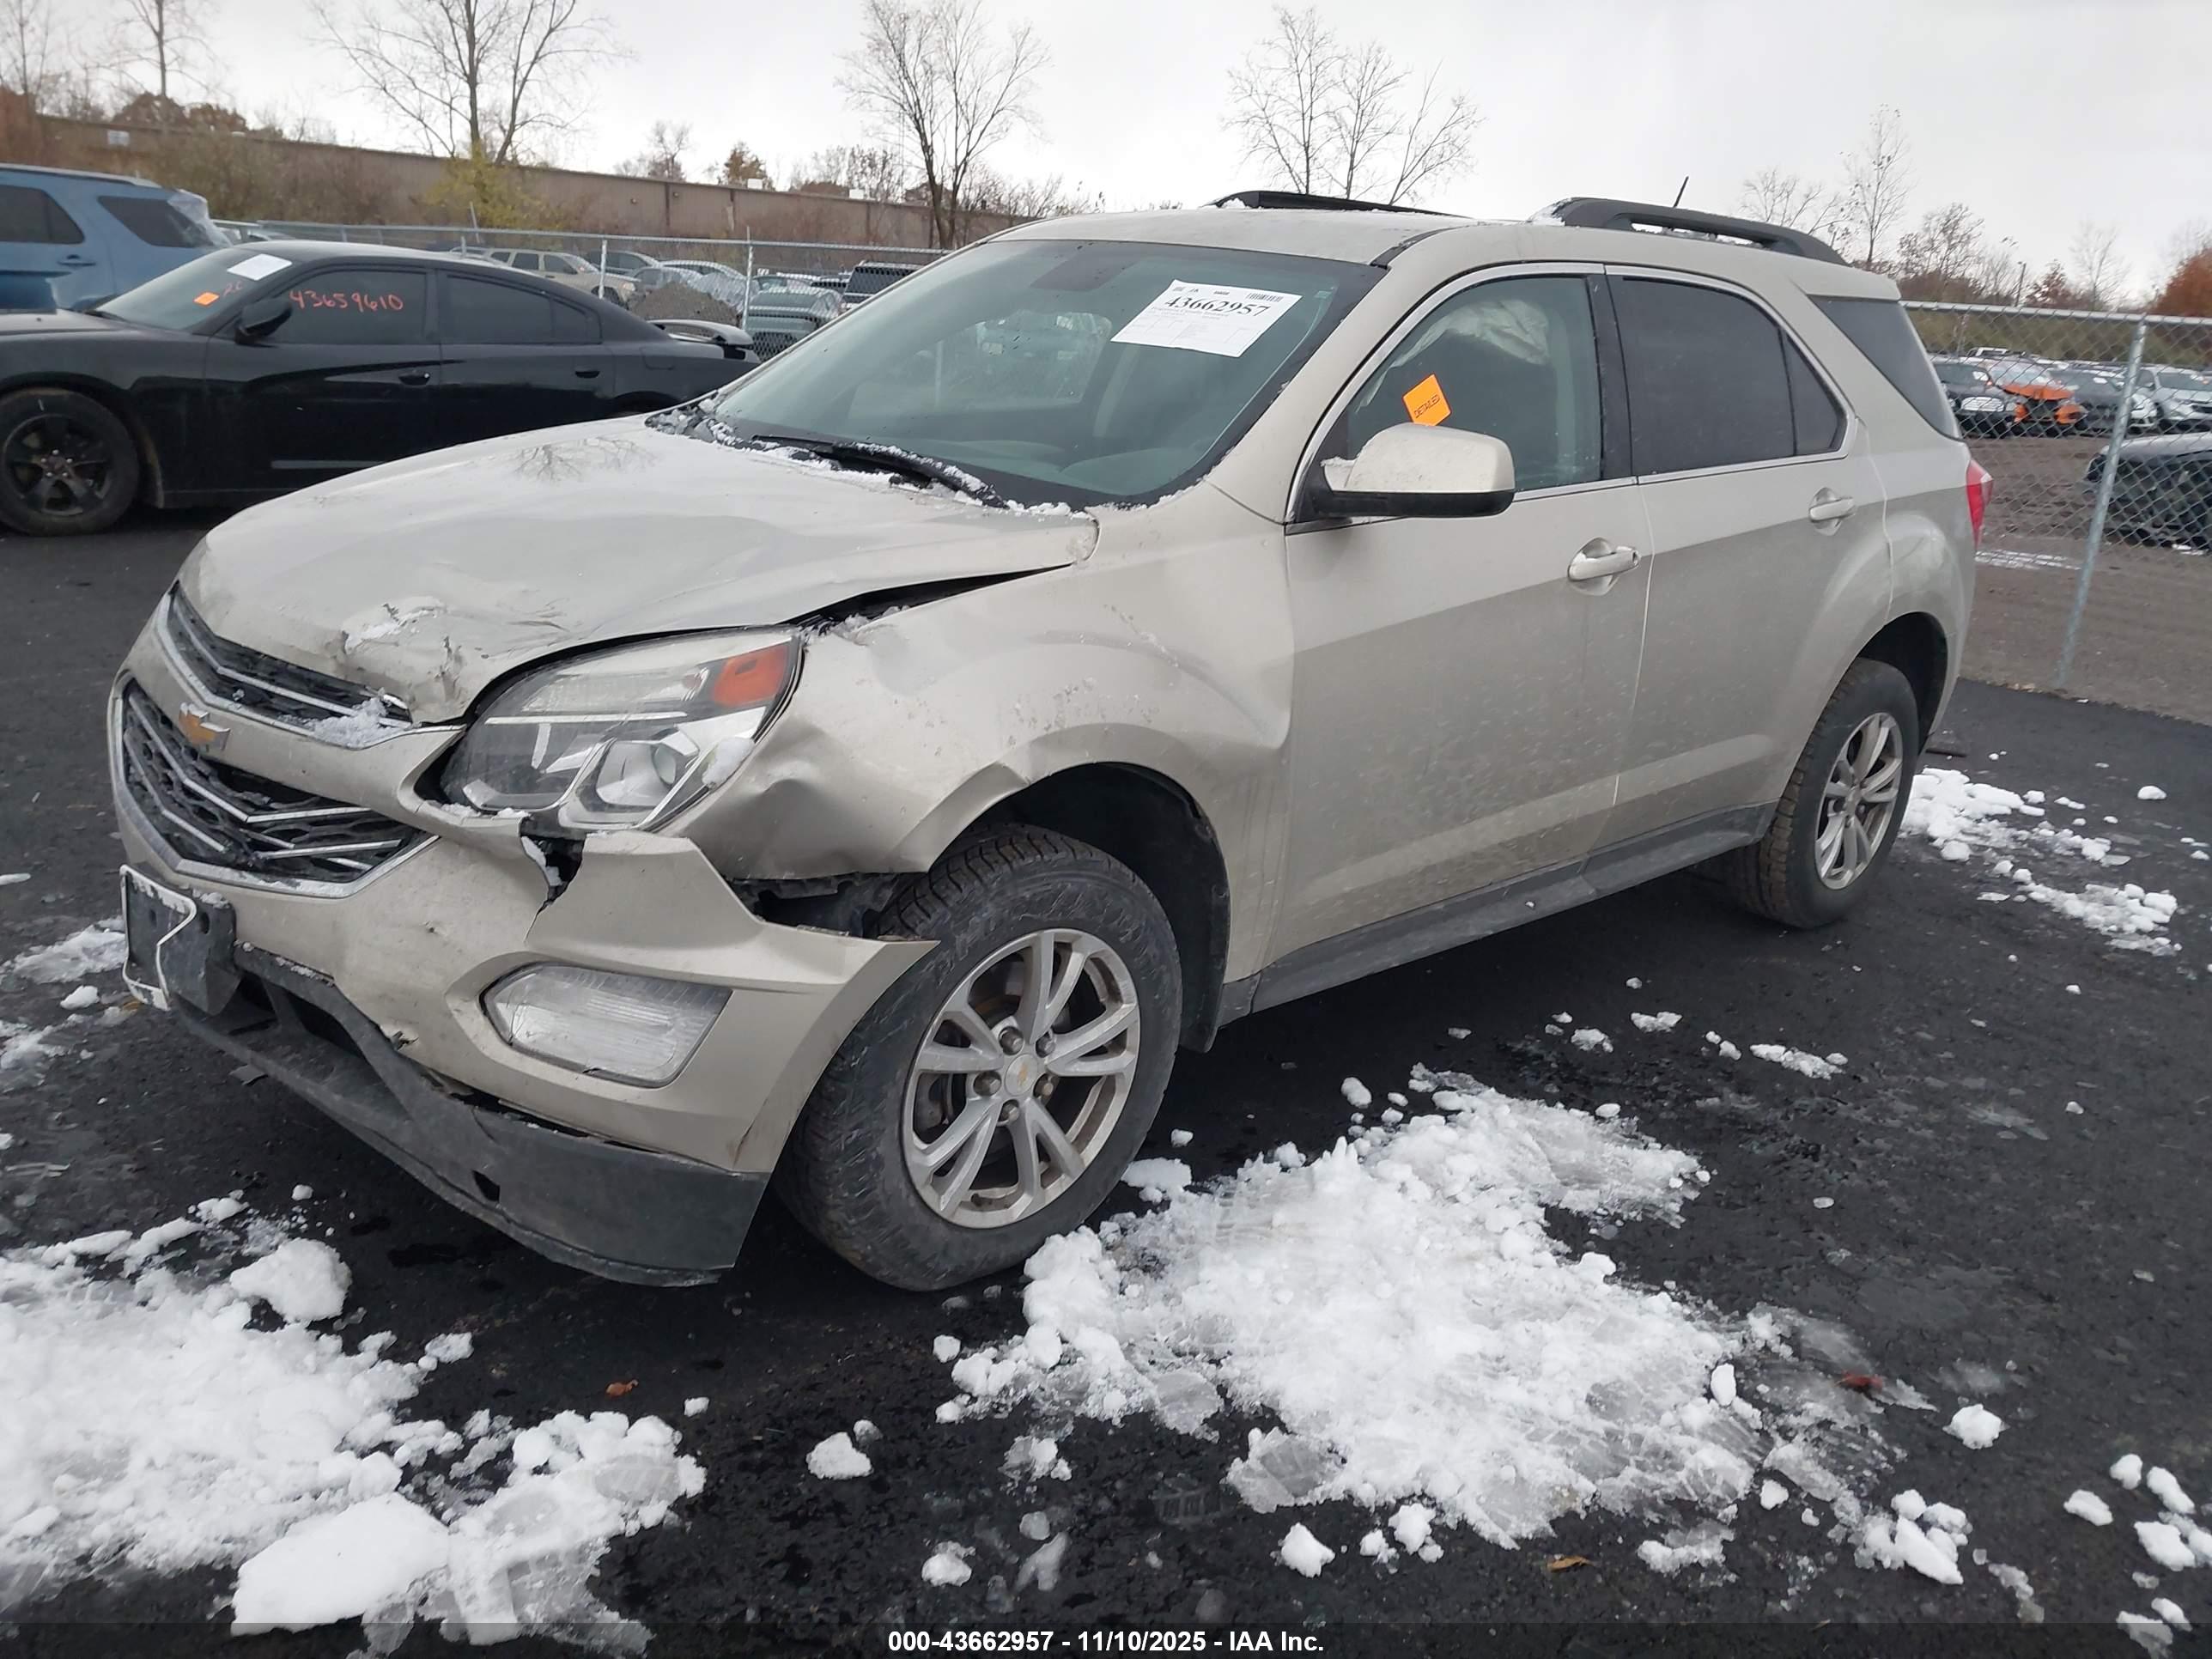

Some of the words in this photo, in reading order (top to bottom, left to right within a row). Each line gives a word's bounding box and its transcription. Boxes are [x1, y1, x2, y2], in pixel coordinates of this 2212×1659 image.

[289, 289, 404, 313] 43659610
[1165, 295, 1271, 317] 43662957
[1413, 393, 1441, 419] DETAILED
